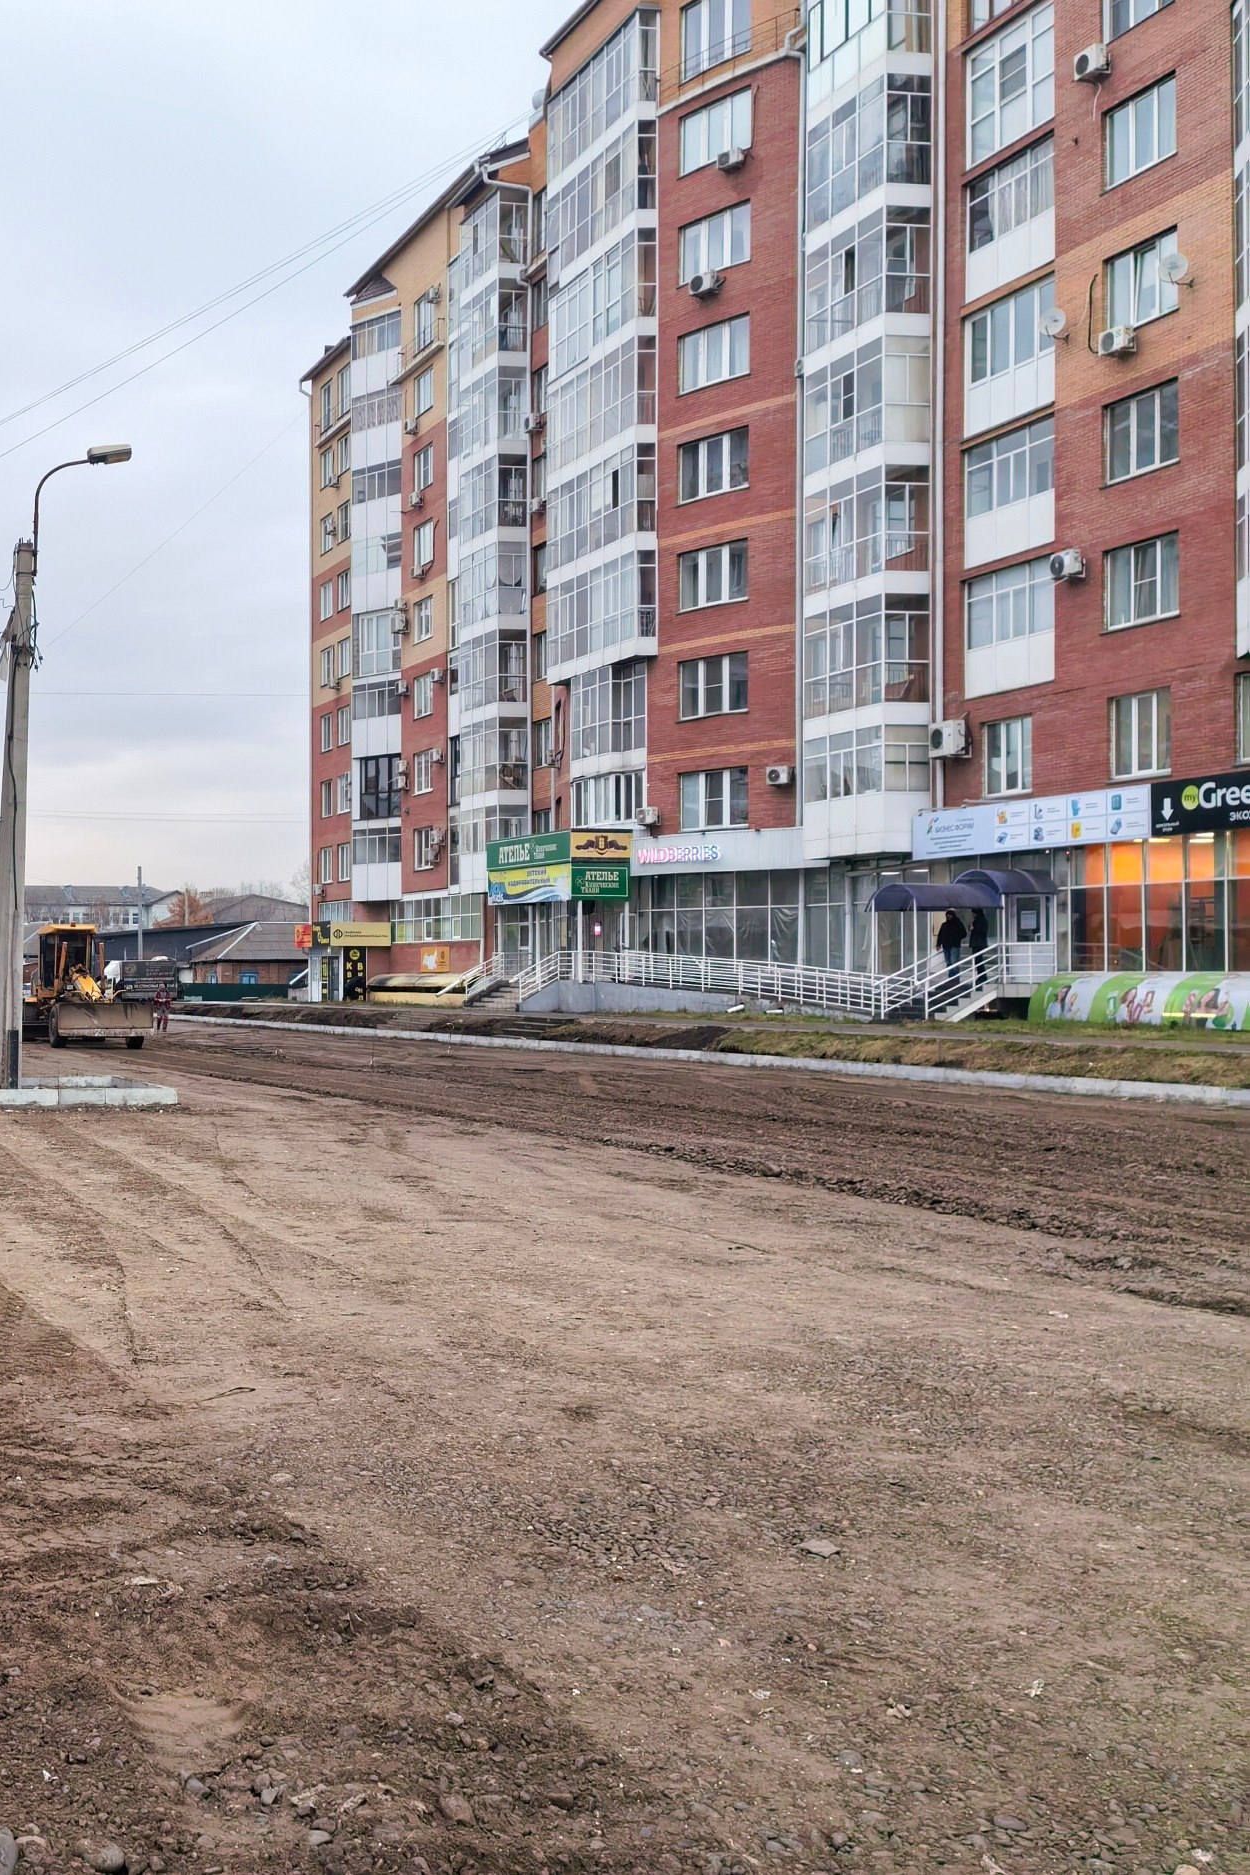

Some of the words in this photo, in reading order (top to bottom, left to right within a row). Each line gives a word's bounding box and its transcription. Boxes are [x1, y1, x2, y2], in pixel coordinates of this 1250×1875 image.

[498, 843, 530, 864] АТЕЛЬЕ
[637, 844, 721, 864] WILDBERRIES
[585, 871, 619, 881] АТЕЛЬЕ
